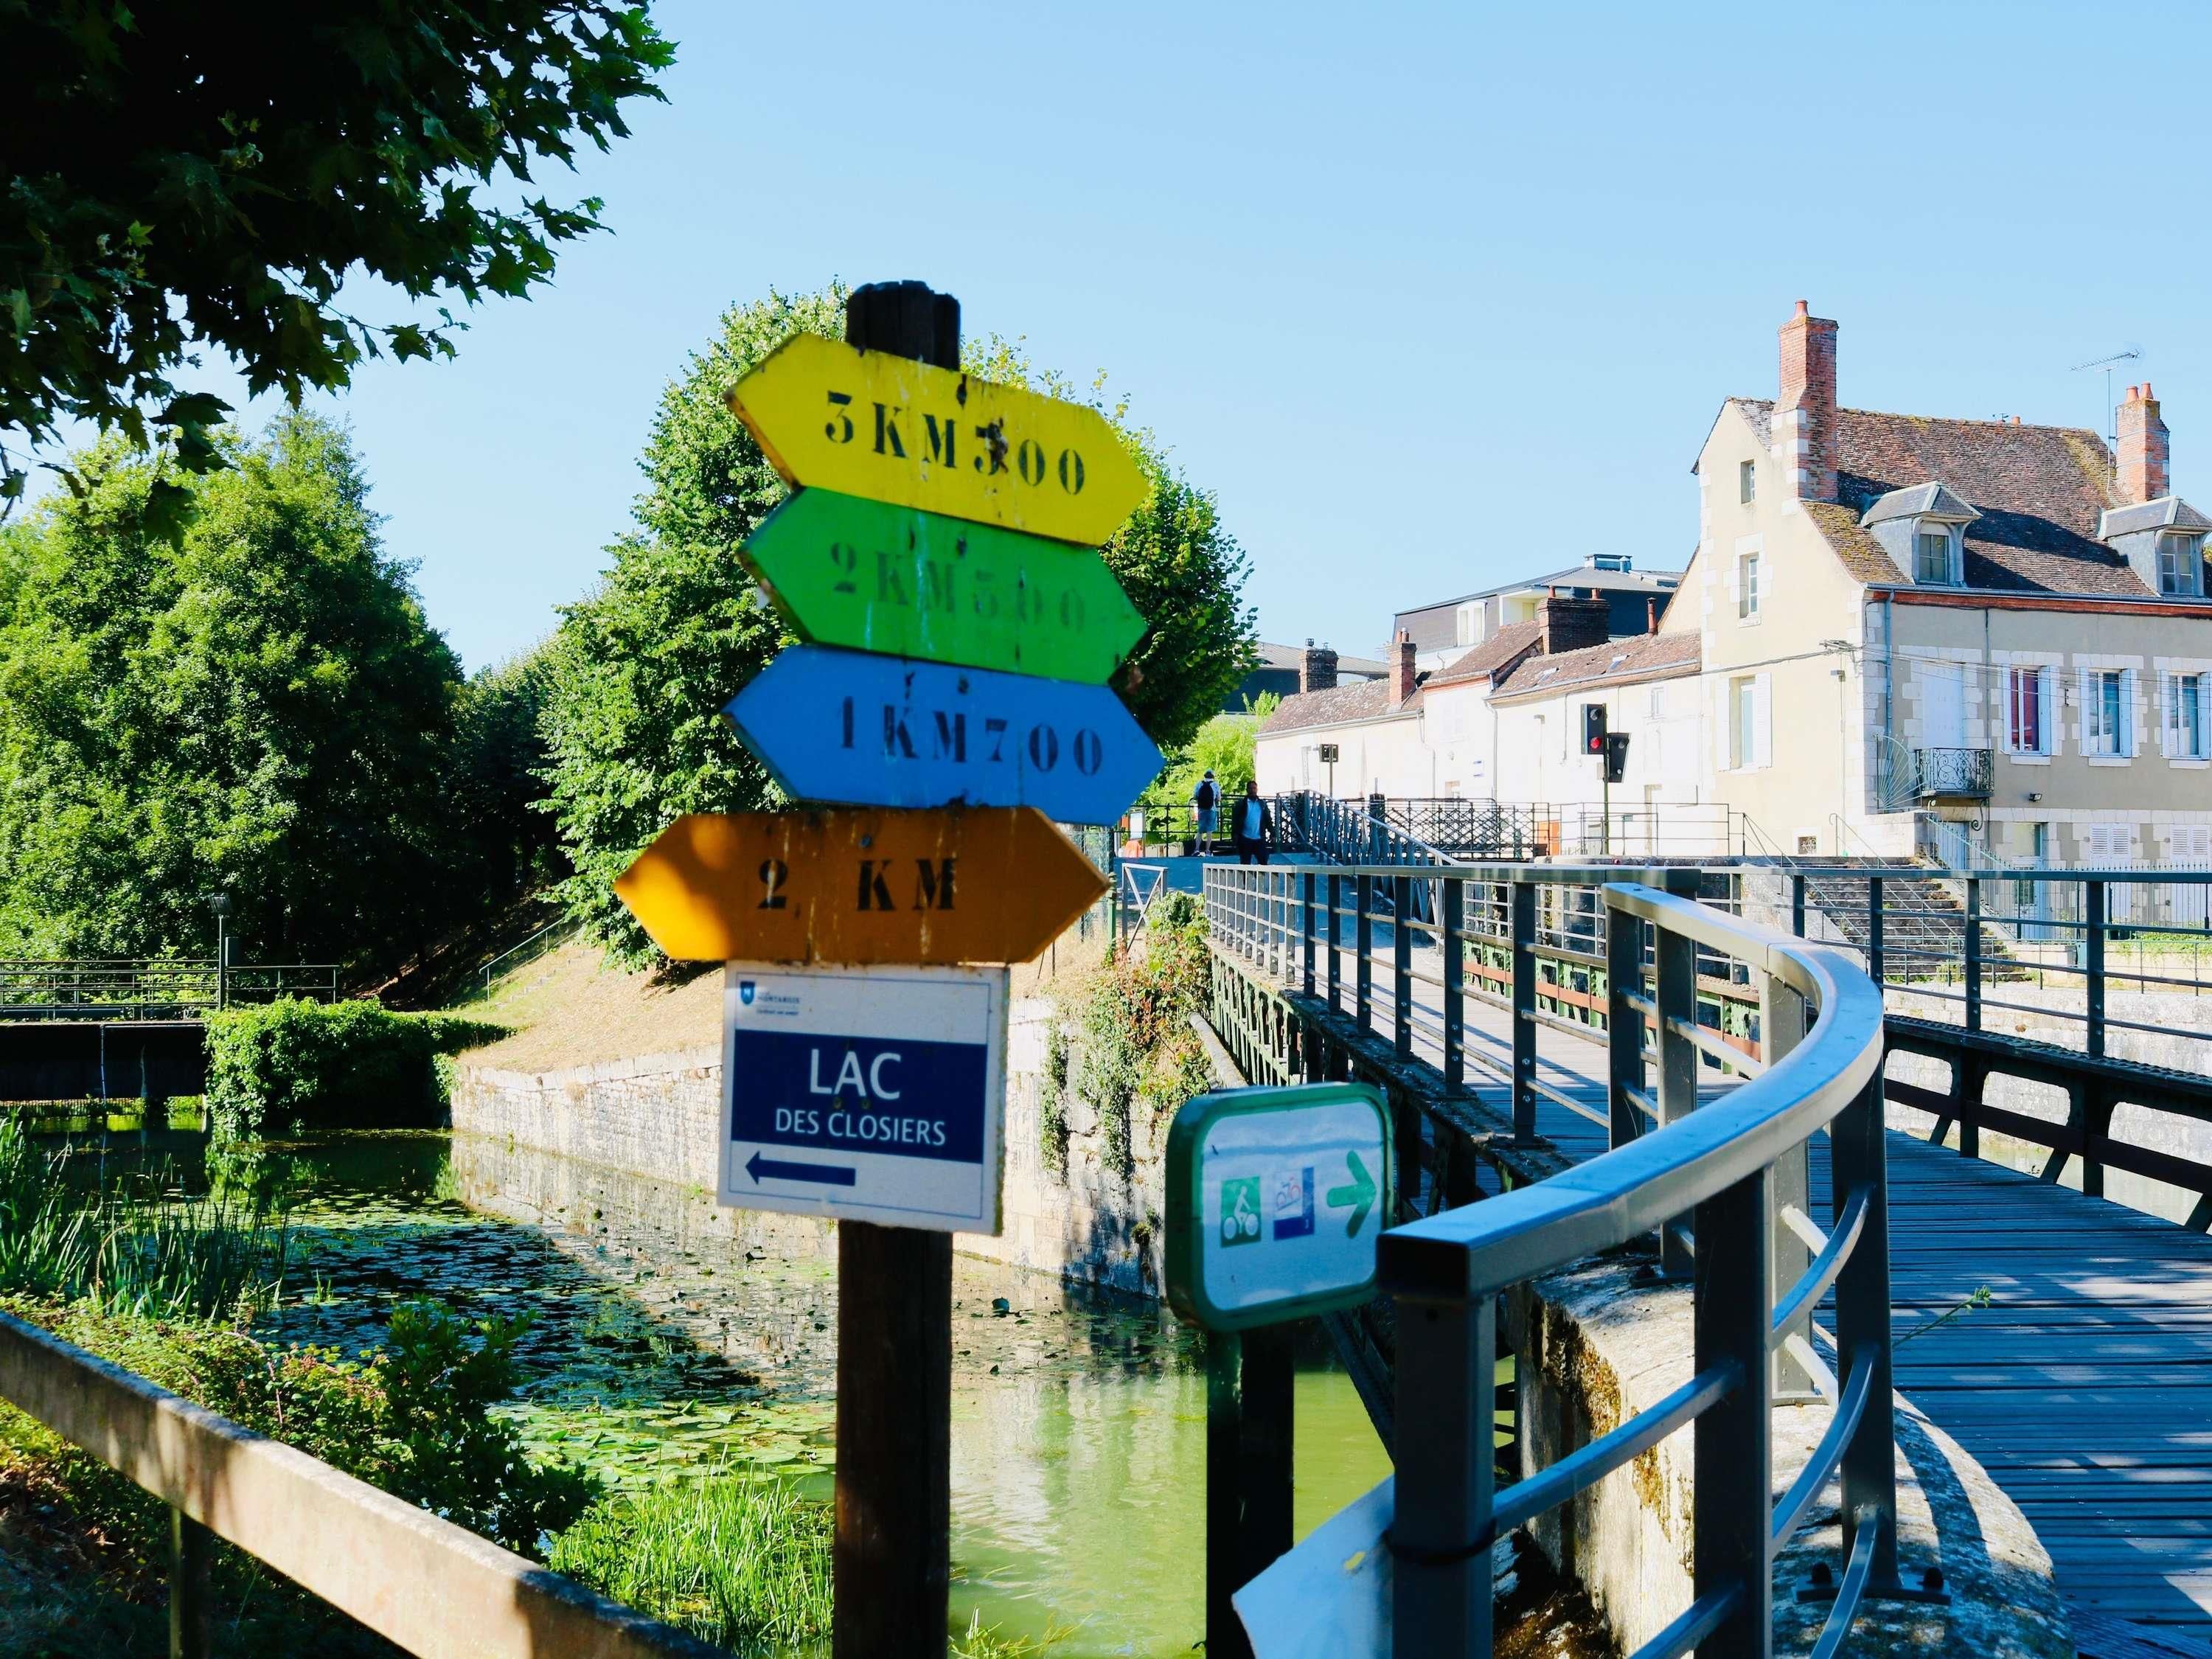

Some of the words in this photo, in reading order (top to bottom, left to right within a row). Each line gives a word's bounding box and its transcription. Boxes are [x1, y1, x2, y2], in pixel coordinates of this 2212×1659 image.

[757, 858, 787, 909] 2
[810, 1048, 902, 1100] LAC
[775, 1108, 820, 1135] DES
[827, 1112, 947, 1147] CLOSIERS
